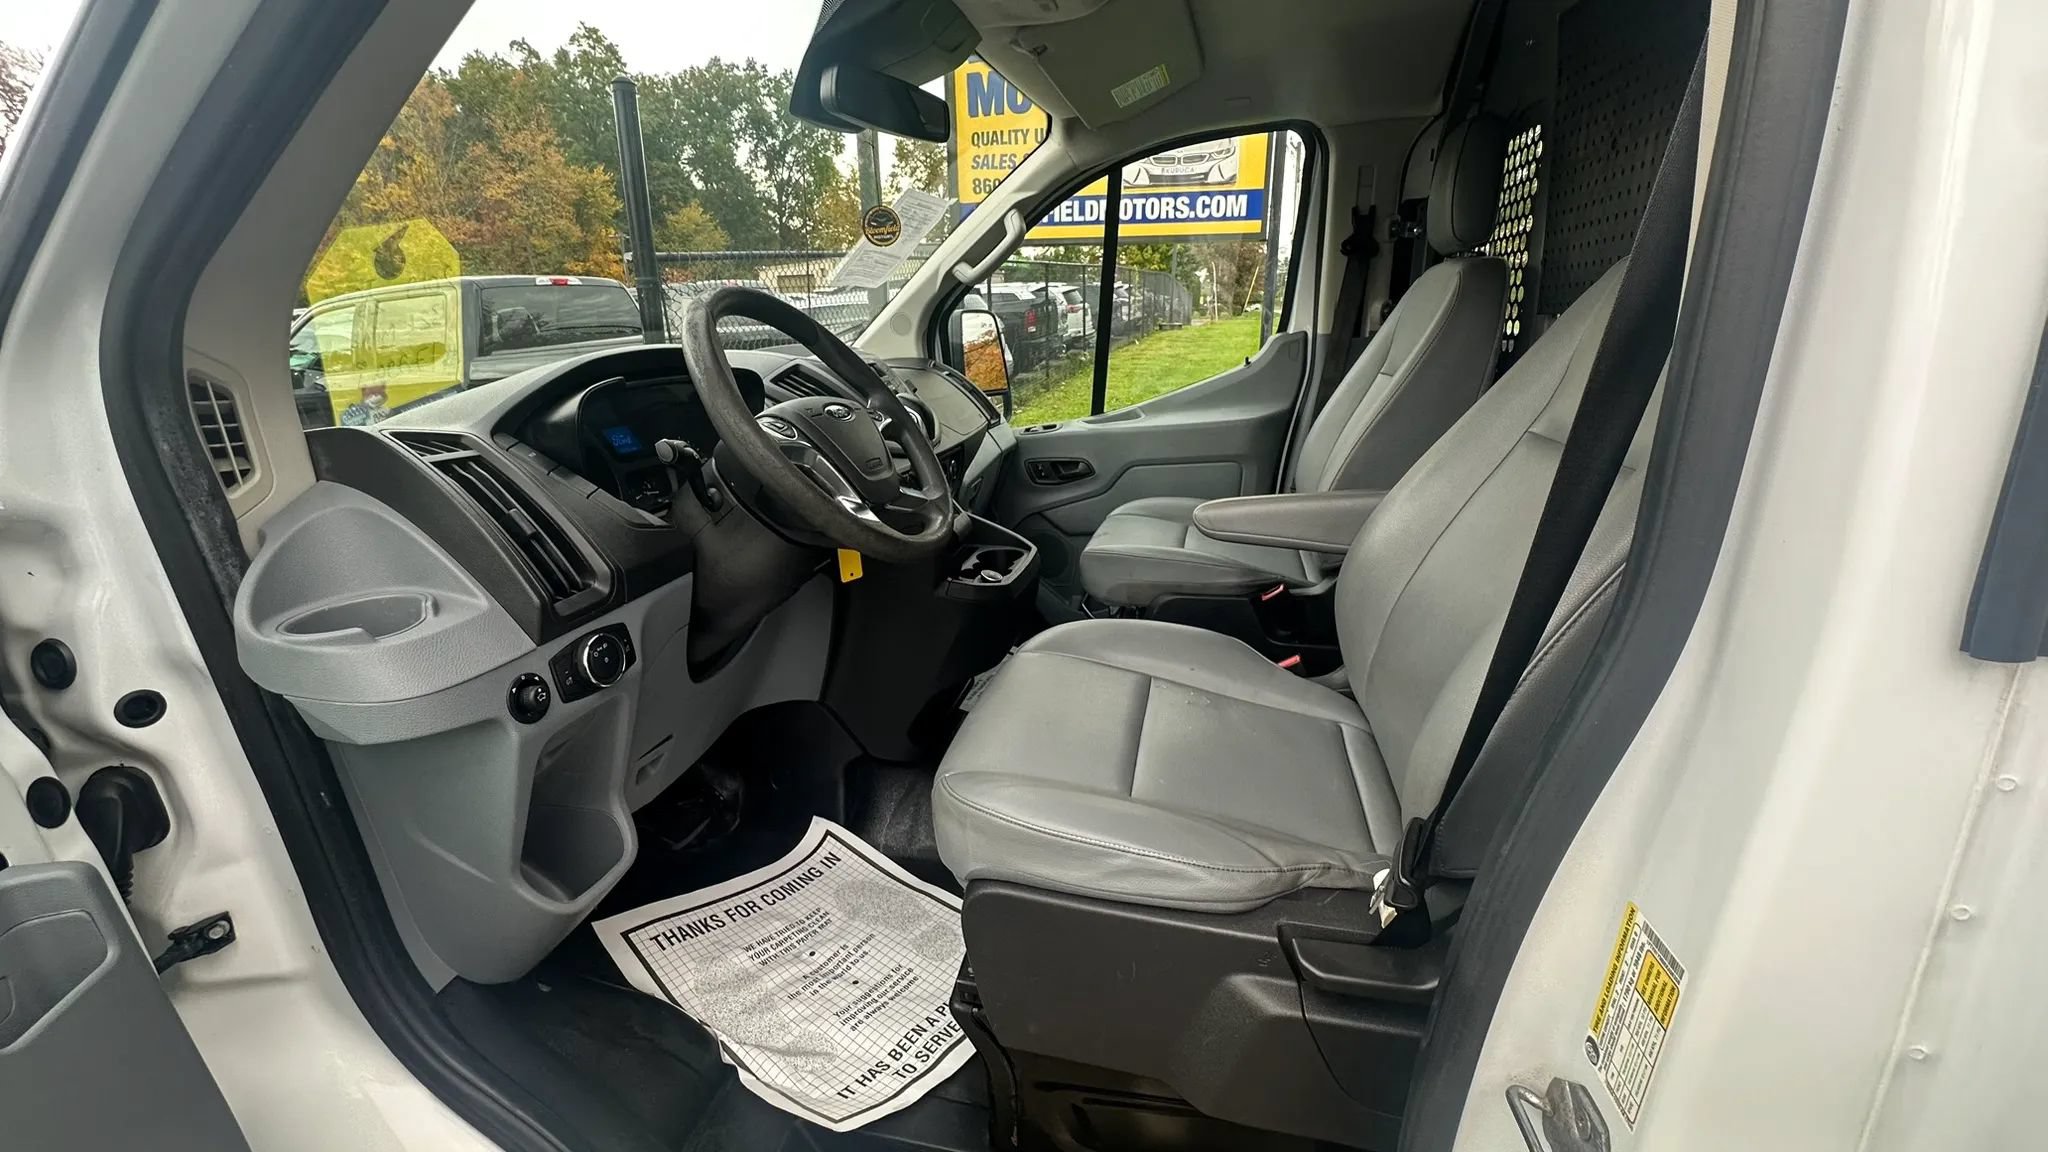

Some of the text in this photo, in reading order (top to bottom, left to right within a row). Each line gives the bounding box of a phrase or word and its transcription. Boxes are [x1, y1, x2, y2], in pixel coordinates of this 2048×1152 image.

[971, 128, 1030, 148] QUALITY
[971, 153, 1018, 170] SALES
[650, 852, 842, 951] THANKS FOR COMING IN
[742, 942, 756, 953] WE
[756, 934, 776, 946] HAVE
[775, 923, 796, 938] TRIED
[804, 908, 822, 920] KEEP
[749, 911, 830, 961] YOUR CARPETING CLEAN
[759, 918, 832, 966] WITH THIS PAPER MAT
[788, 933, 876, 1000] the most important person
[810, 950, 841, 976] customer
[818, 980, 832, 990] the
[832, 964, 852, 980] world
[850, 958, 860, 966] to
[1592, 1016, 1601, 1034] TIRE
[1599, 998, 1607, 1016] AND
[1604, 962, 1618, 998] LOADING
[1616, 907, 1636, 964] INFORMATION
[832, 964, 903, 1018] Your suggestions for
[840, 968, 914, 1026] improving our service
[1654, 980, 1668, 1014] ADDITIONAL
[1660, 985, 1676, 1025] INFORMATION
[850, 1020, 864, 1032] are
[864, 1000, 890, 1020] always
[837, 1084, 856, 1100] IT
[856, 1060, 891, 1088] HAS
[888, 1024, 928, 1062] BEEN
[924, 1016, 940, 1028] A
[892, 1020, 962, 1080] TO SERVE
